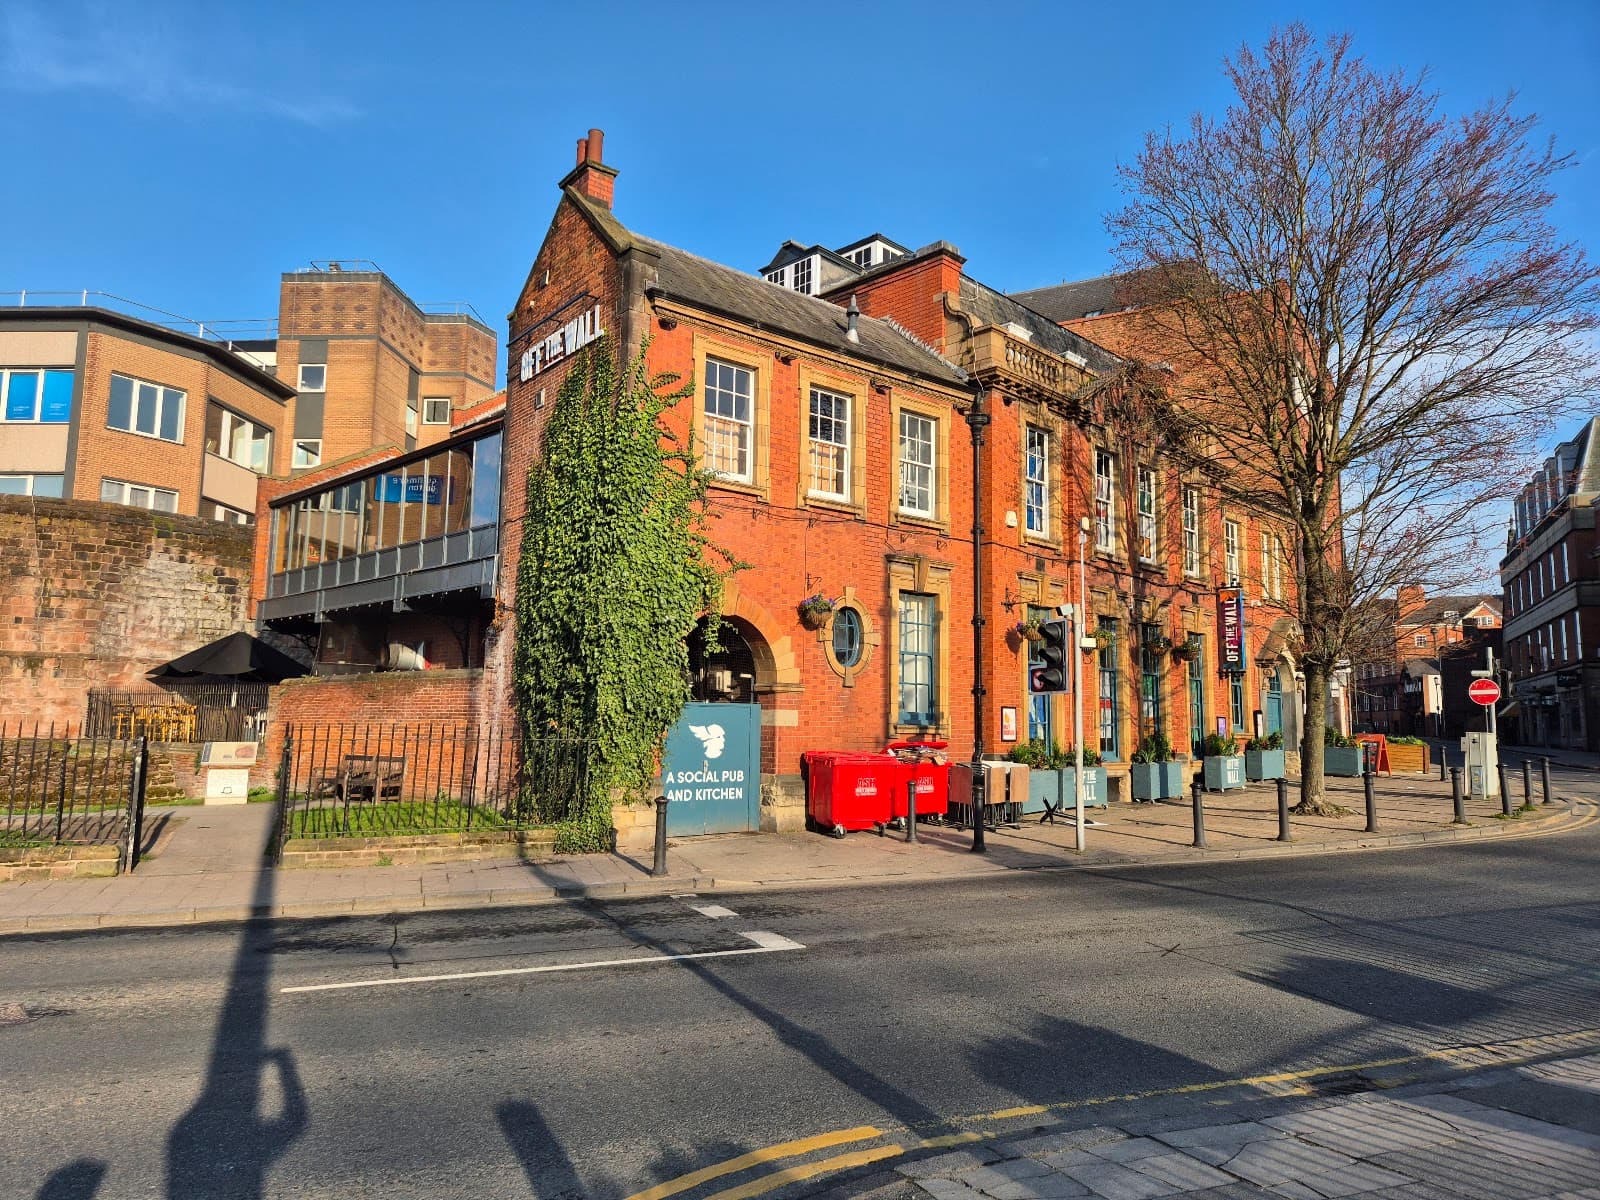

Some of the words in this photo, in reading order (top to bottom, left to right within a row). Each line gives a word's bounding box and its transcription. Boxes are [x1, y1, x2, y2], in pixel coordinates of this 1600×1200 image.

[521, 340, 545, 382] OFF
[545, 327, 565, 361] THE
[565, 304, 605, 356] WALL
[1224, 596, 1238, 626] WALL
[1225, 626, 1236, 641] THE
[1226, 642, 1239, 662] OFF
[666, 772, 675, 784] A
[677, 771, 719, 783] SOCIAL
[722, 770, 744, 782] PUB
[666, 789, 693, 801] AND
[695, 787, 743, 800] KITCHEN
